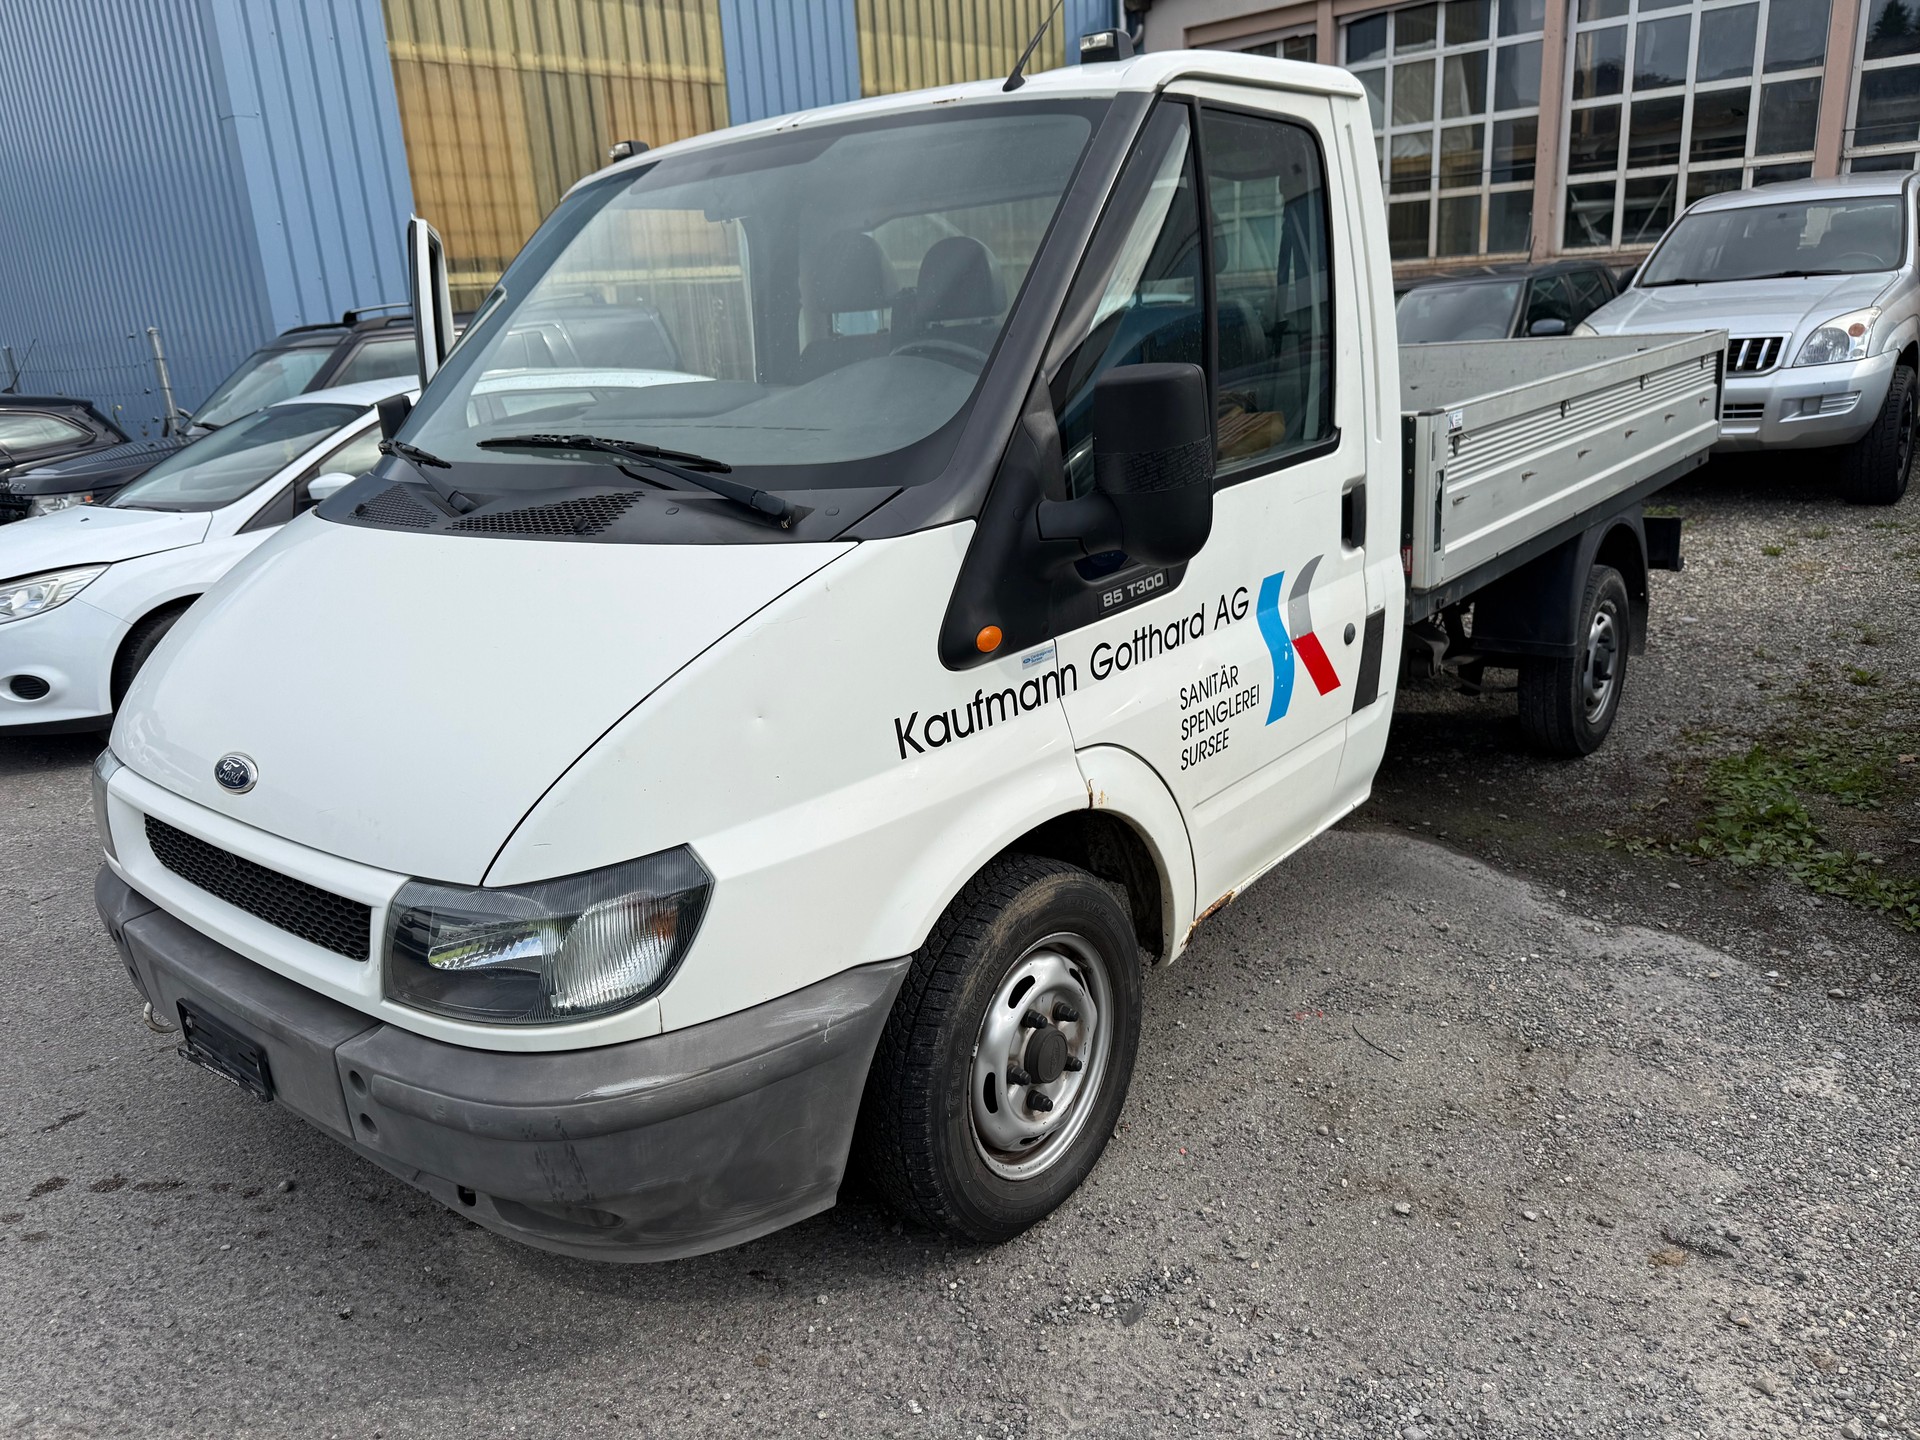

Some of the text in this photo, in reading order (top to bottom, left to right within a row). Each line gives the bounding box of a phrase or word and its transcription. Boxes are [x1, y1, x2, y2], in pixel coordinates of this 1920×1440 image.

[1102, 572, 1165, 608] 85 T300
[894, 586, 1250, 760] Kaufmann Gotthard AG
[1180, 664, 1239, 711] SANITÄR
[1181, 684, 1260, 742] SPENGLEREI
[218, 758, 244, 785] Ford
[1180, 727, 1230, 772] SURSEE
